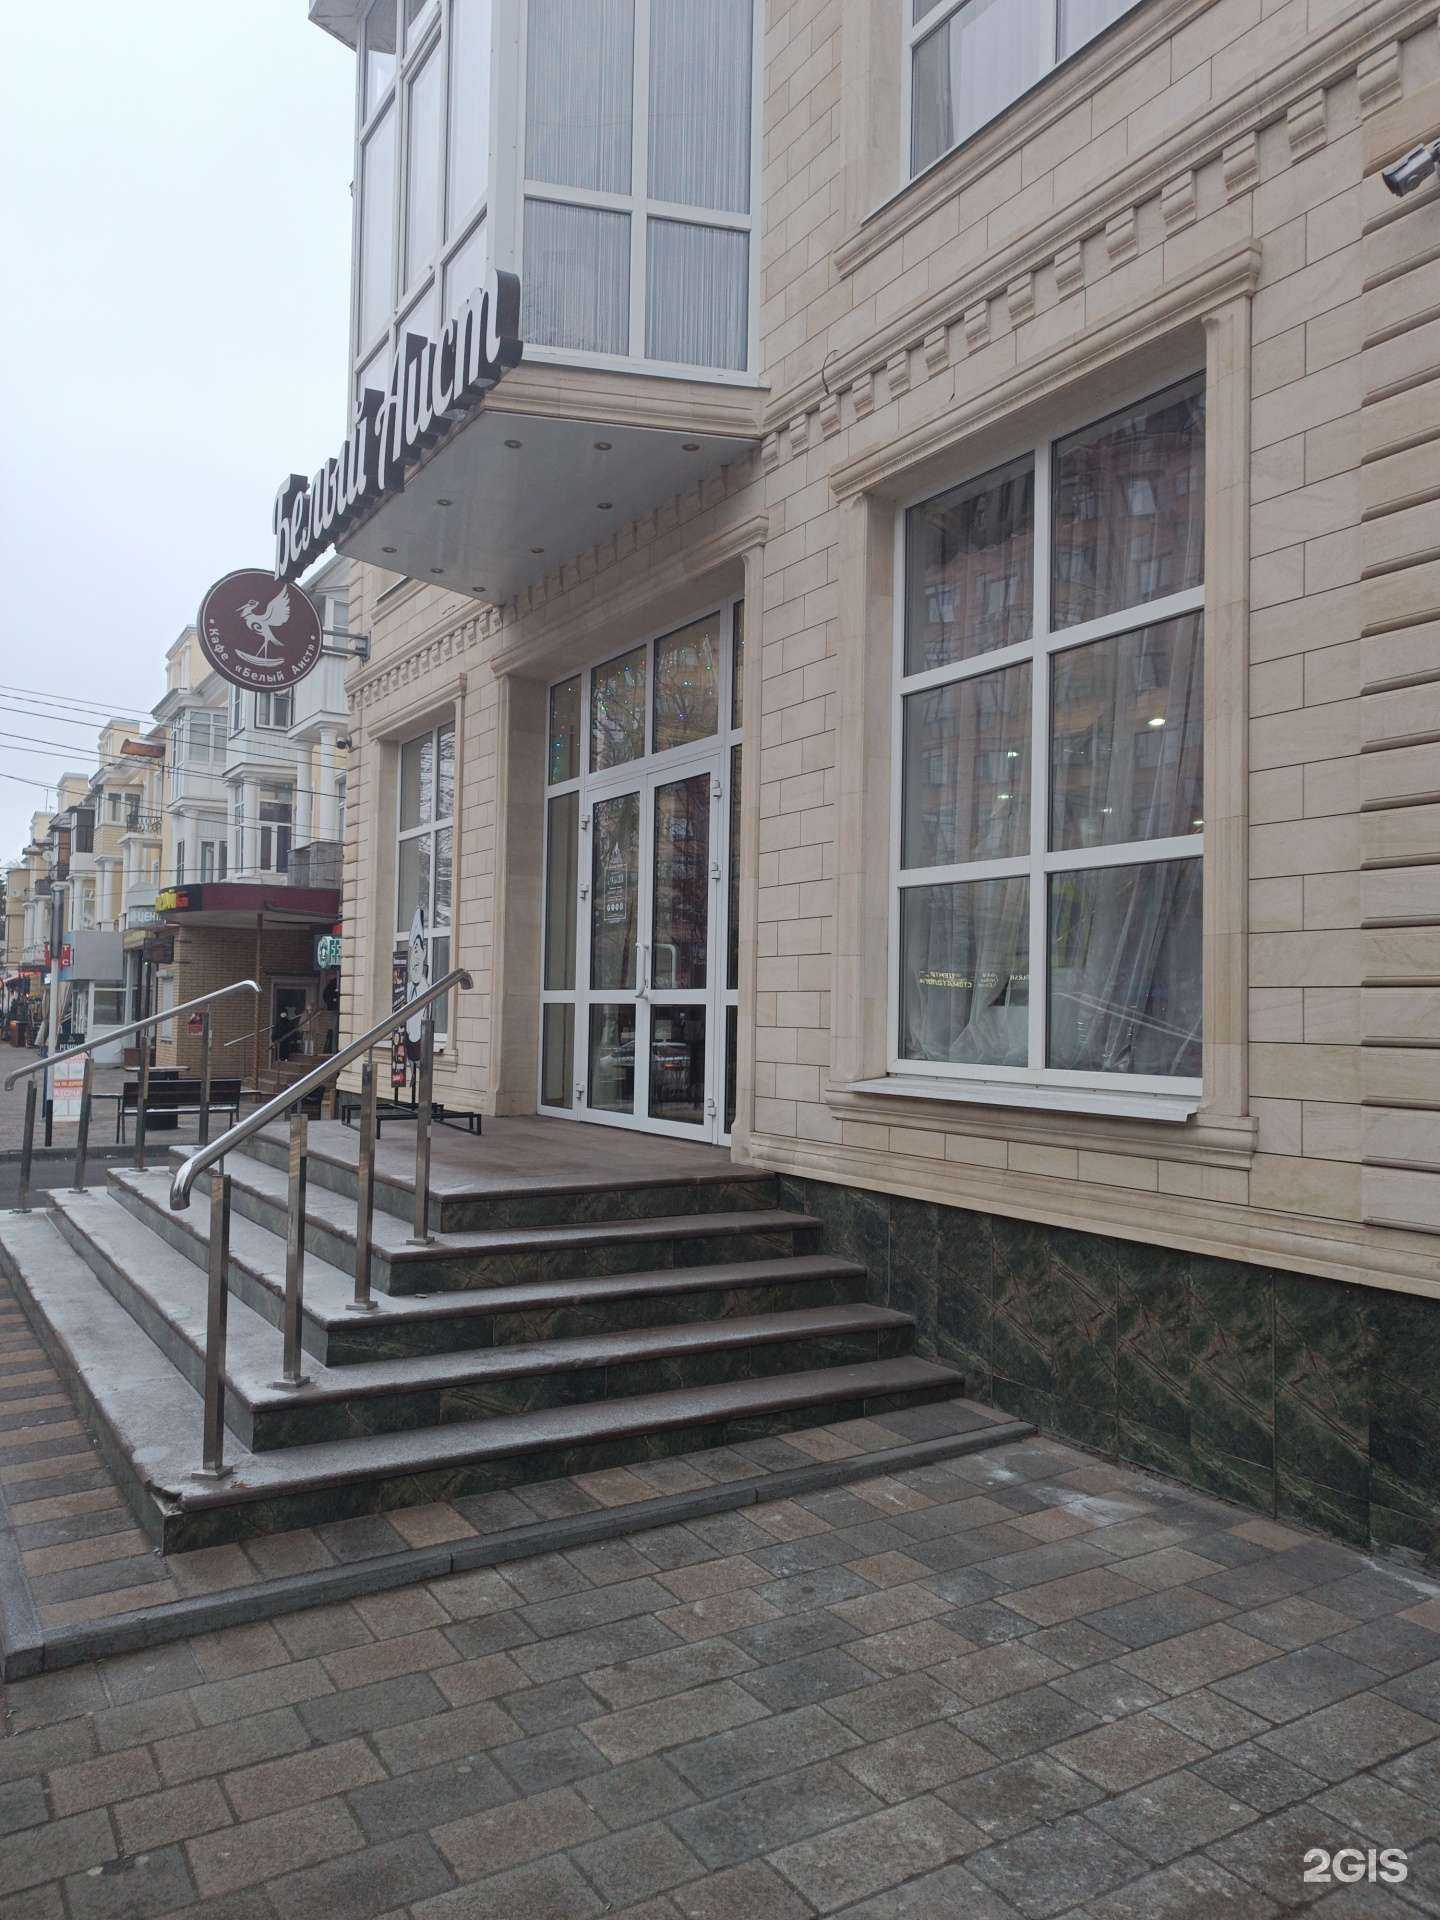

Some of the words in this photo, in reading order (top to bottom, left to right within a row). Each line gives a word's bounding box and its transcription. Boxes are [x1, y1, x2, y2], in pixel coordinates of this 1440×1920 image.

[272, 399, 368, 581] Белый
[374, 268, 503, 490] Аист
[208, 627, 230, 662] Кафе
[234, 664, 286, 683] «Белый
[290, 643, 316, 675] Аист»
